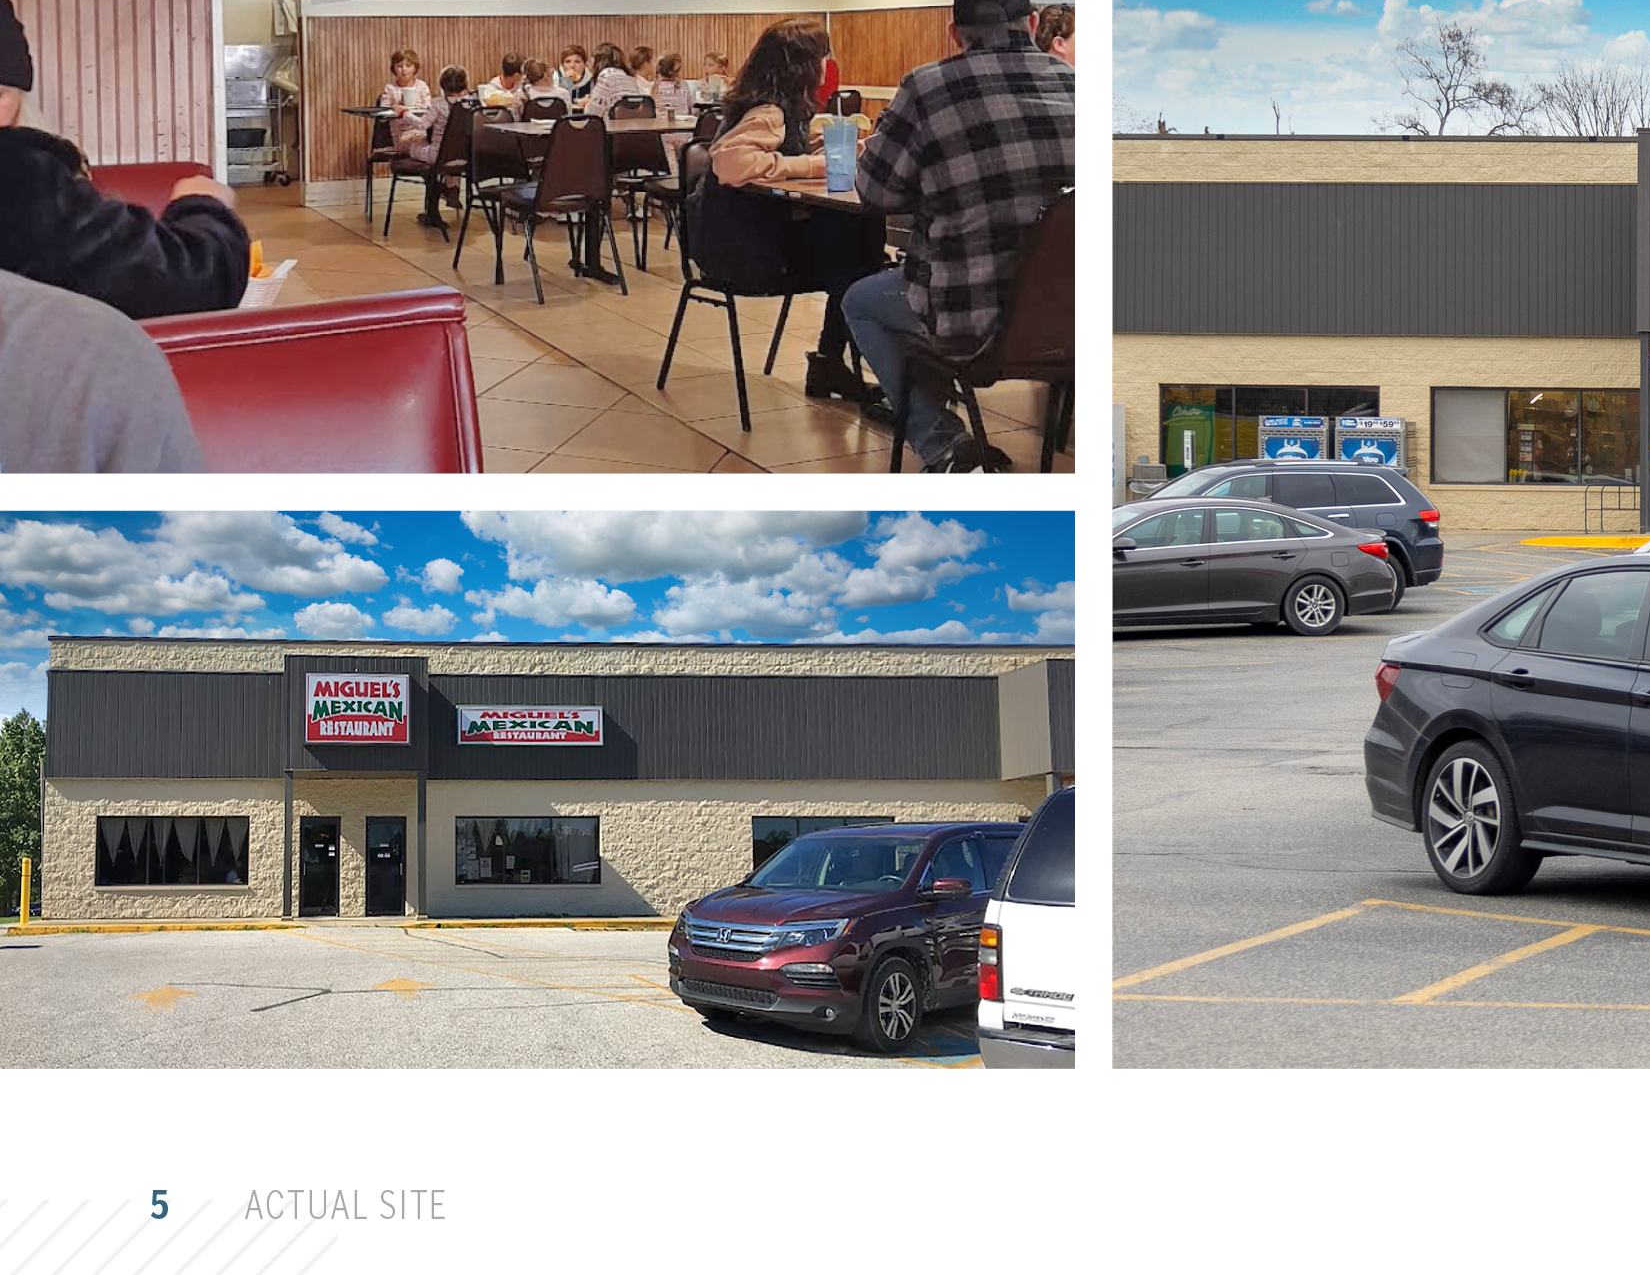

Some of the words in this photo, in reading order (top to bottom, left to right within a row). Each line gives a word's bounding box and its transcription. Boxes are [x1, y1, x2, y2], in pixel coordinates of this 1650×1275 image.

[314, 679, 401, 699] MIGUEL'S
[311, 699, 404, 724] MEXICAN
[479, 710, 580, 720] MIGUEL'S
[319, 721, 395, 737] RESTAURANT
[466, 719, 594, 736] MEXICAN
[492, 730, 567, 741] RESTAURANT
